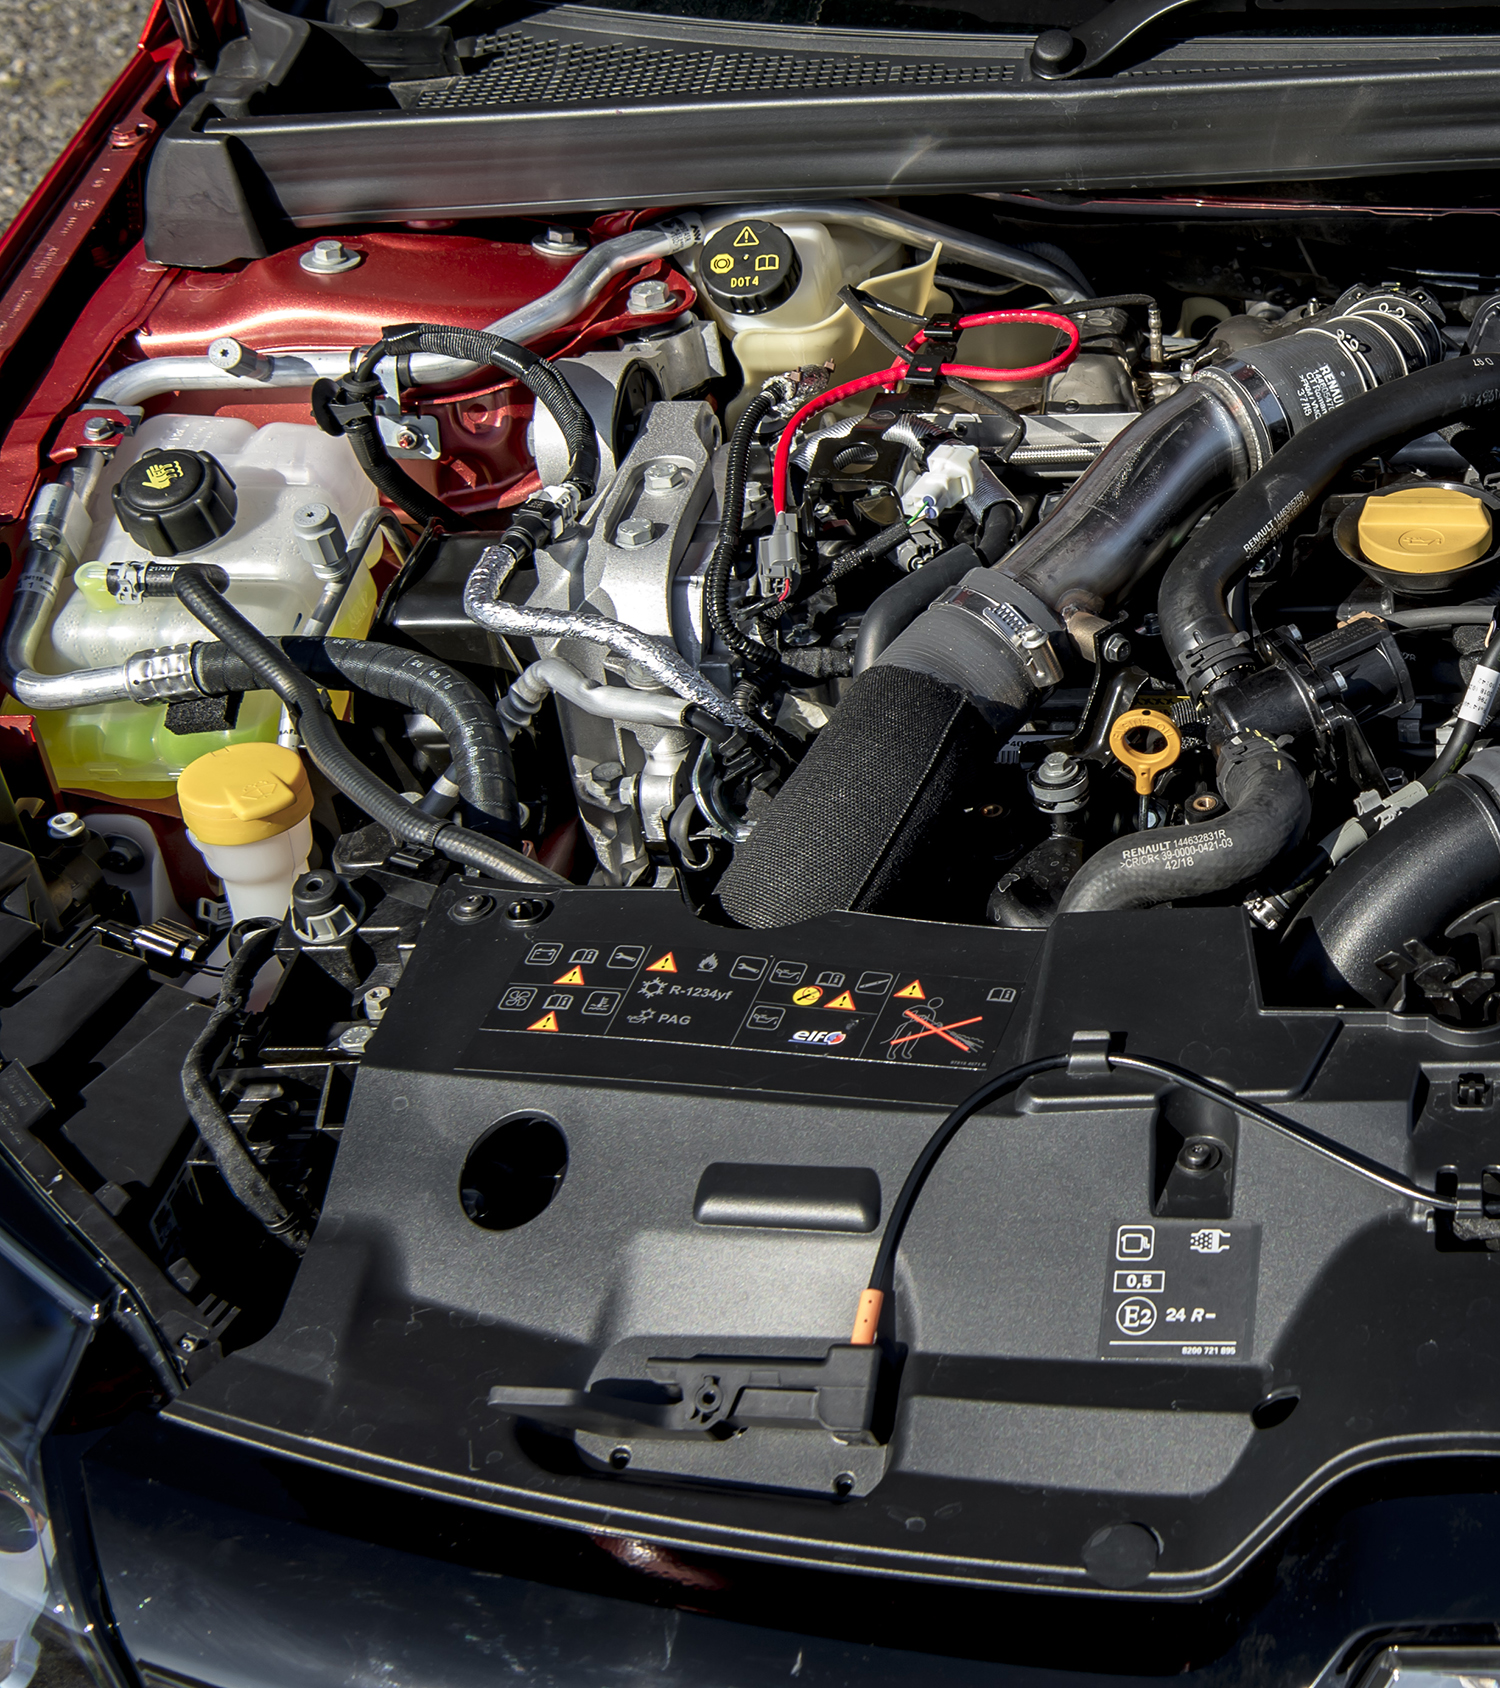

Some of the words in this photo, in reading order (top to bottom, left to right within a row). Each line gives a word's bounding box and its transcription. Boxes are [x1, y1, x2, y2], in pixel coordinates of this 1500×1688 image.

[730, 276, 751, 288] DOT
[752, 275, 760, 286] 4
[1297, 387, 1313, 416] 37/18
[1243, 519, 1275, 553] RENAULT
[1156, 722, 1175, 740] OIL
[1122, 841, 1171, 859] RENAULT
[1173, 829, 1226, 848] 144632831R
[1120, 853, 1160, 869] >CR/CR<
[1161, 838, 1234, 861] 39-0000-0421-03
[1164, 856, 1195, 871] 42/18
[669, 985, 733, 1001] R-1234yf
[657, 1013, 691, 1025] PAG
[792, 1030, 827, 1042] elf
[1126, 1274, 1153, 1289] 0,5
[1122, 1305, 1153, 1328] E2
[1165, 1307, 1187, 1322] 24
